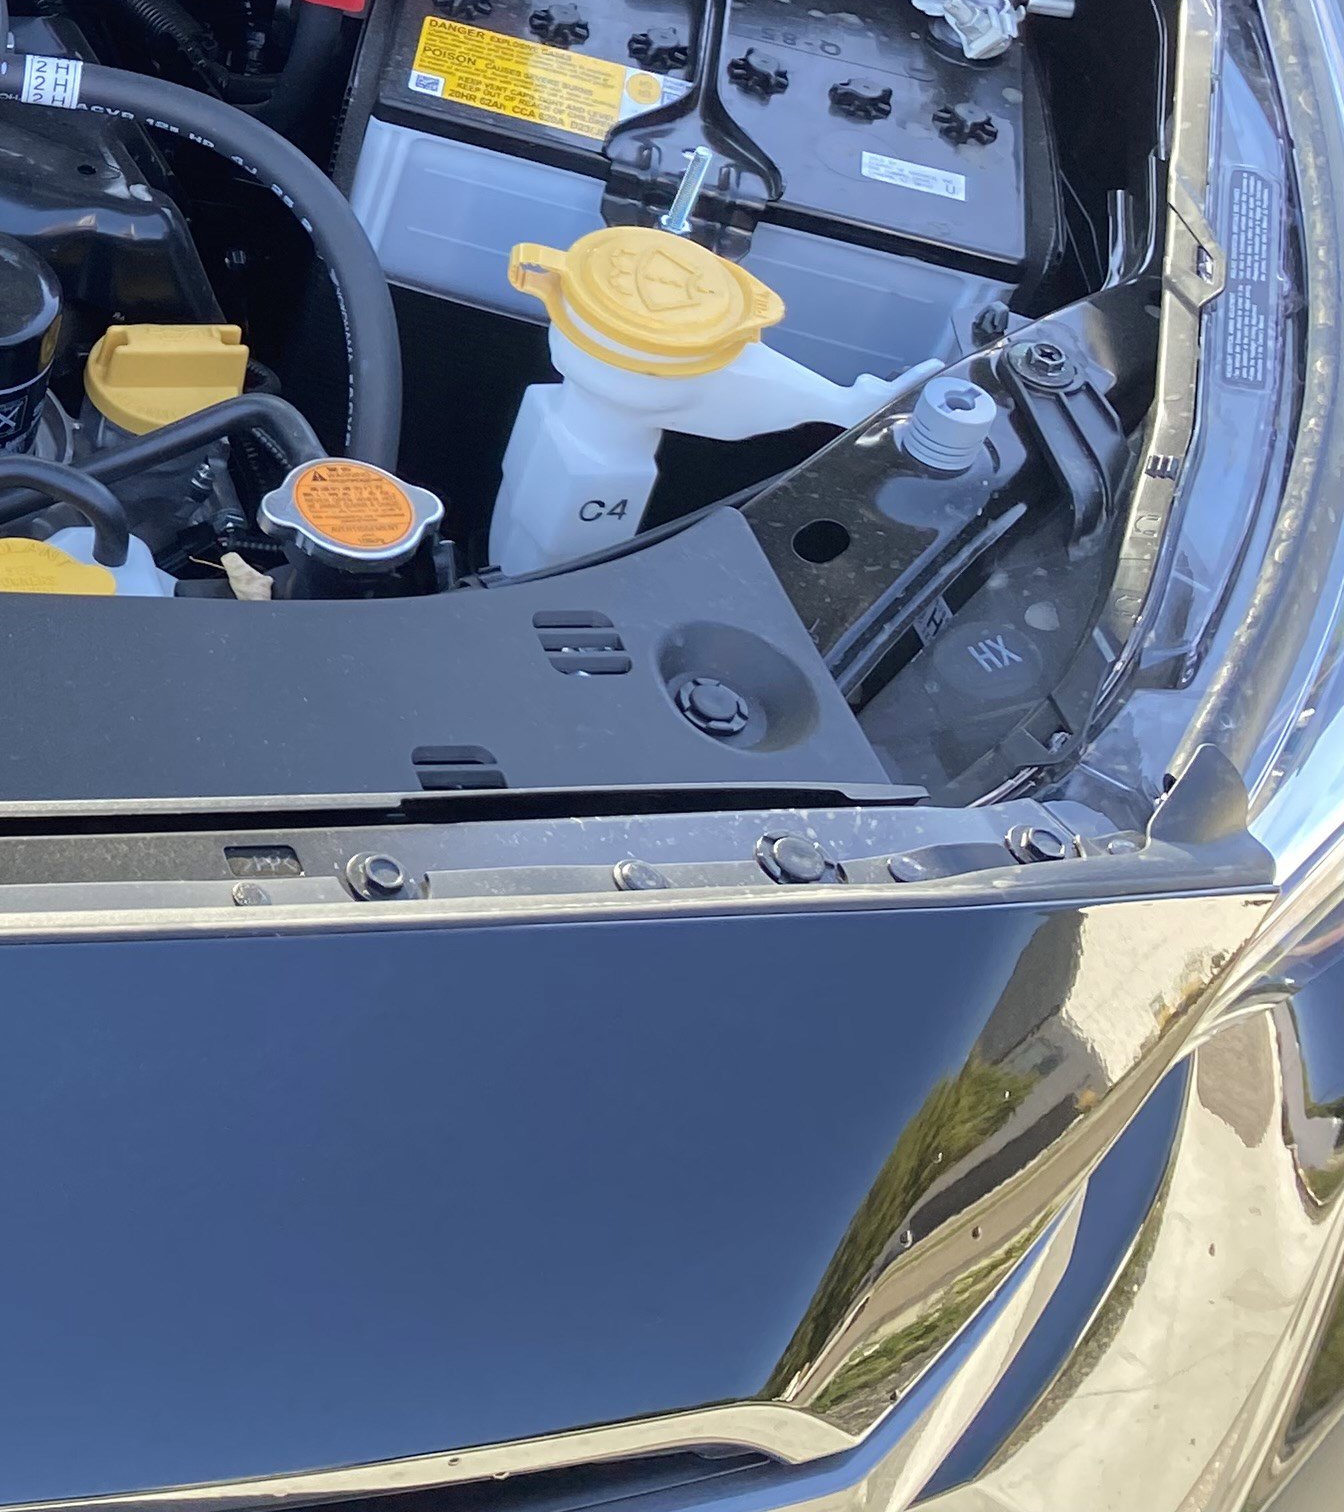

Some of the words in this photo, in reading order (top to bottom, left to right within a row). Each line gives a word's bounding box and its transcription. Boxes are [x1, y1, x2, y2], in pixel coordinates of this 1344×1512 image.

[428, 18, 486, 40] DANGER
[422, 45, 477, 66] POISON
[36, 60, 48, 73] 2
[55, 62, 69, 76] H
[34, 76, 46, 91] 2
[53, 77, 68, 93] H
[33, 93, 43, 102] 2
[51, 94, 66, 105] H
[76, 103, 134, 120] ACVR
[511, 104, 536, 118] CCA
[578, 499, 628, 522] C4
[967, 634, 1023, 672] HX
